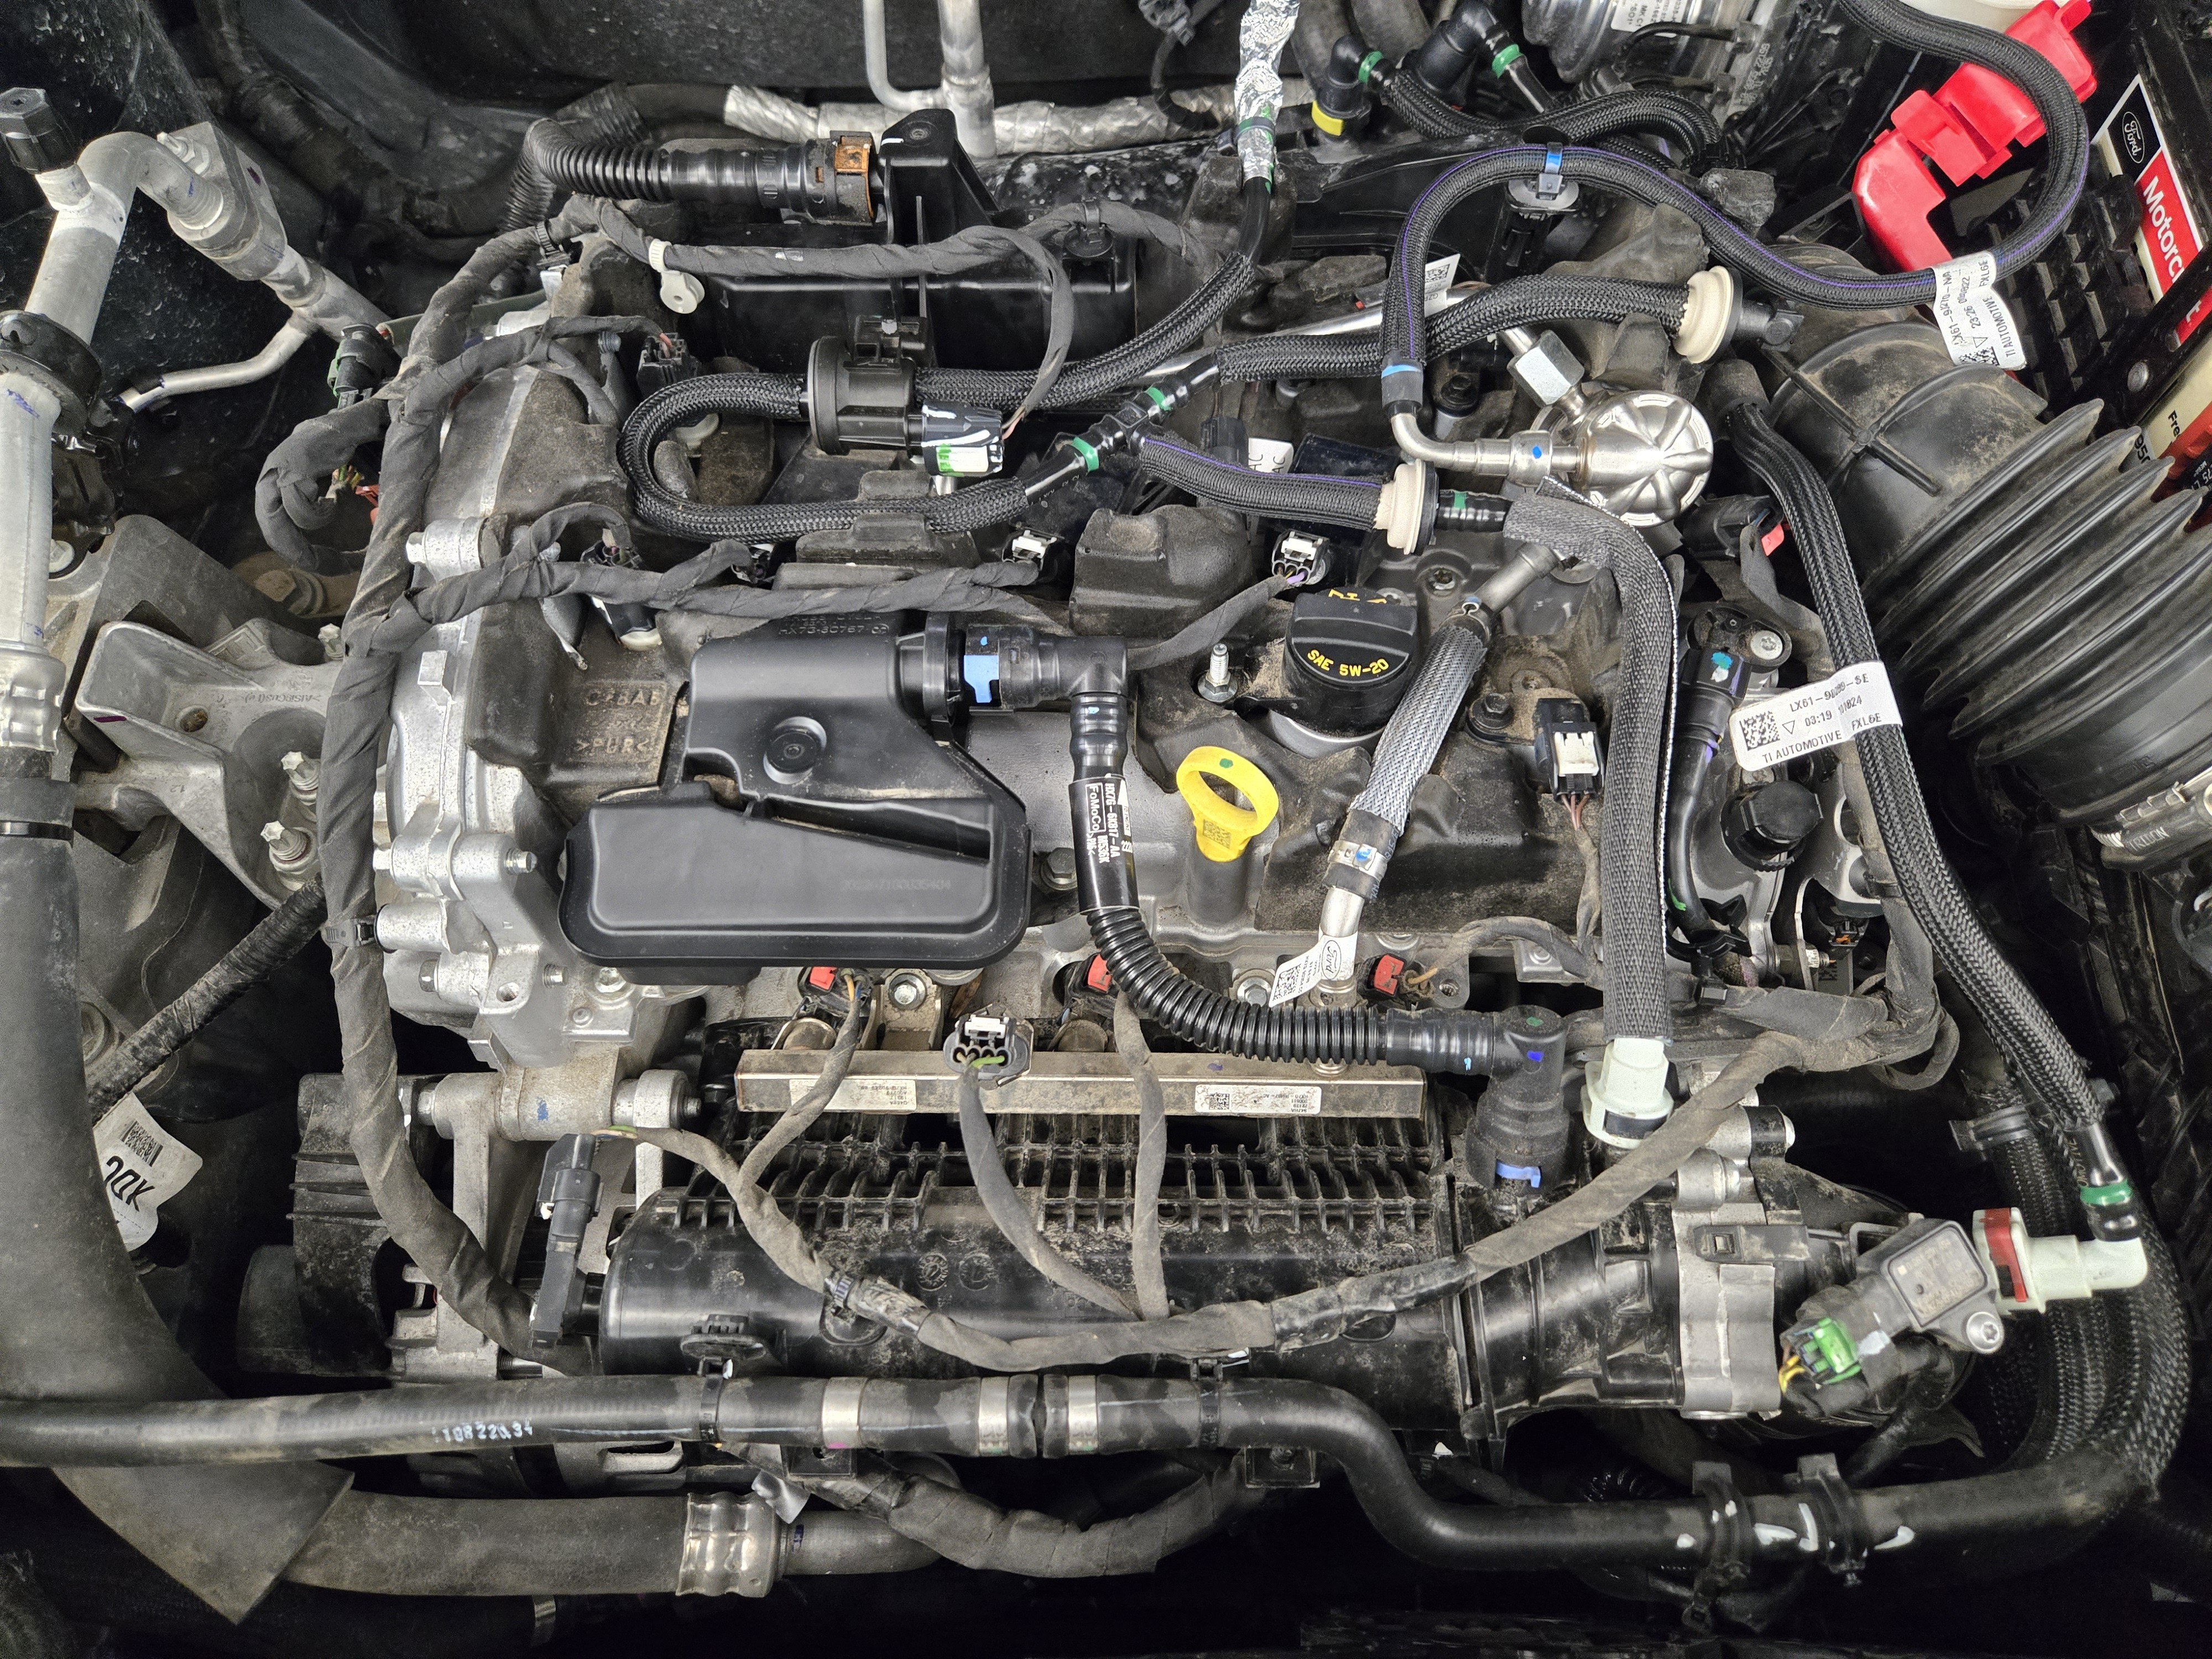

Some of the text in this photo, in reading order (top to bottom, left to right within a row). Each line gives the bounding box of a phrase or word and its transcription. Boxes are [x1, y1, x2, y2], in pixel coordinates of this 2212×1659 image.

[2124, 120, 2140, 159] Ford
[1983, 297, 2013, 347] AUTOMOTIVE
[1307, 649, 1390, 677] SAE 5W-20
[1804, 710, 1833, 727] 03:19
[1762, 713, 1882, 764] TI AUTOMOTIVE FXL6E
[1089, 785, 1102, 831] FoMoCo
[1326, 945, 1339, 973] Ford
